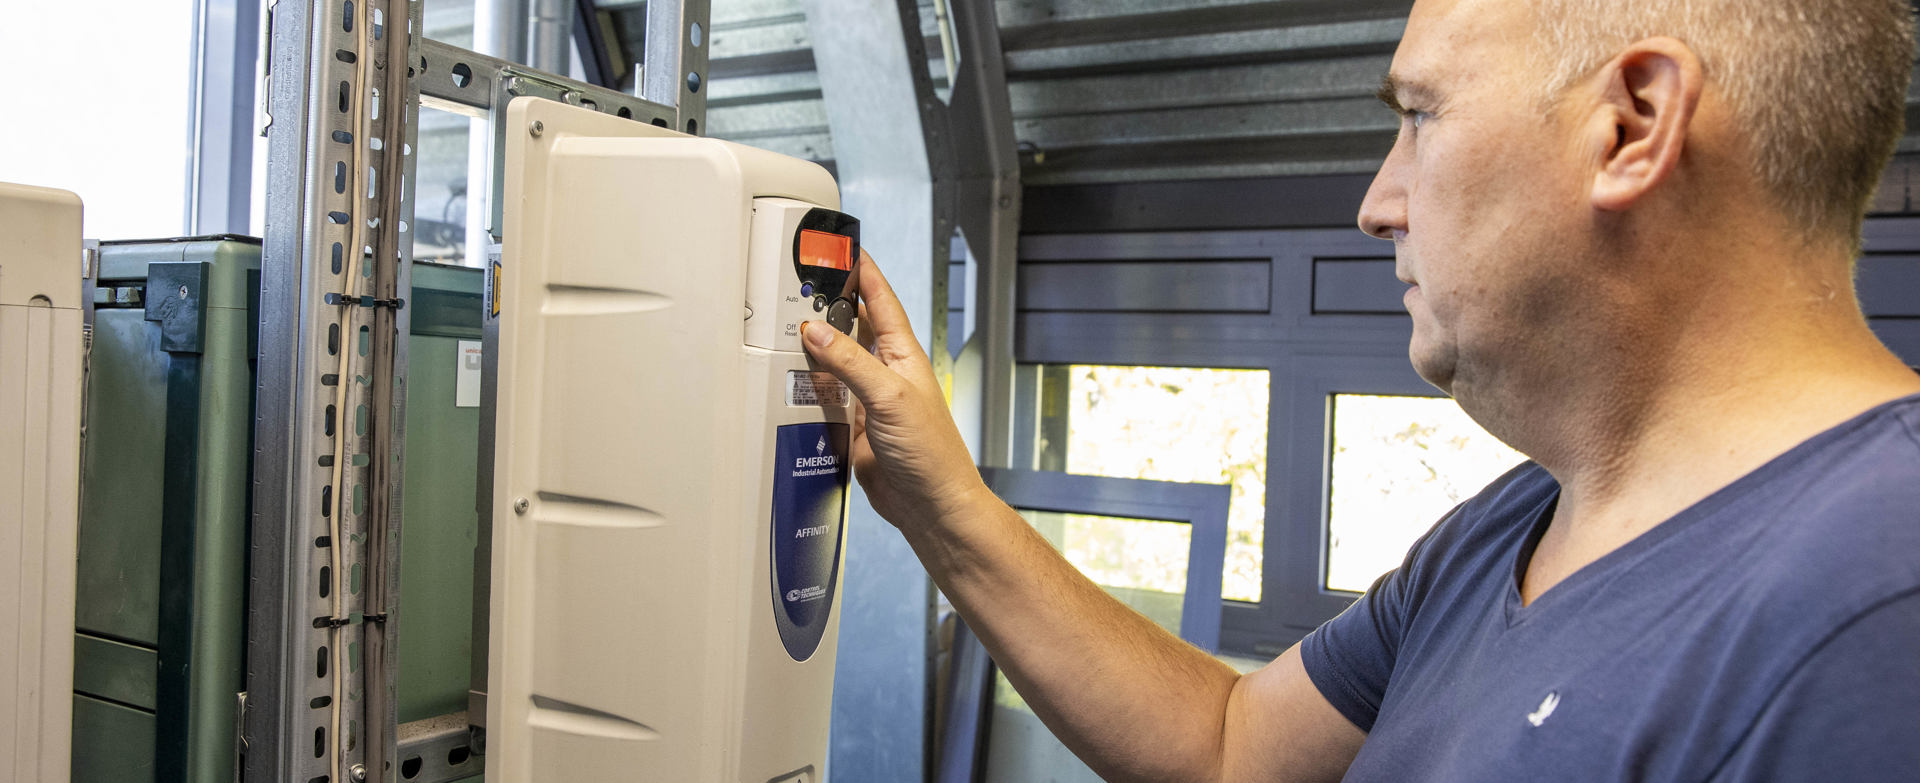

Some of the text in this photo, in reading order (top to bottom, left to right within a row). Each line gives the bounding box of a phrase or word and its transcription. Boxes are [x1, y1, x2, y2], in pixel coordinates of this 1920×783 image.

[796, 455, 839, 468] EMERSON
[792, 468, 816, 477] Industrial
[795, 525, 830, 538] AFFINITY
